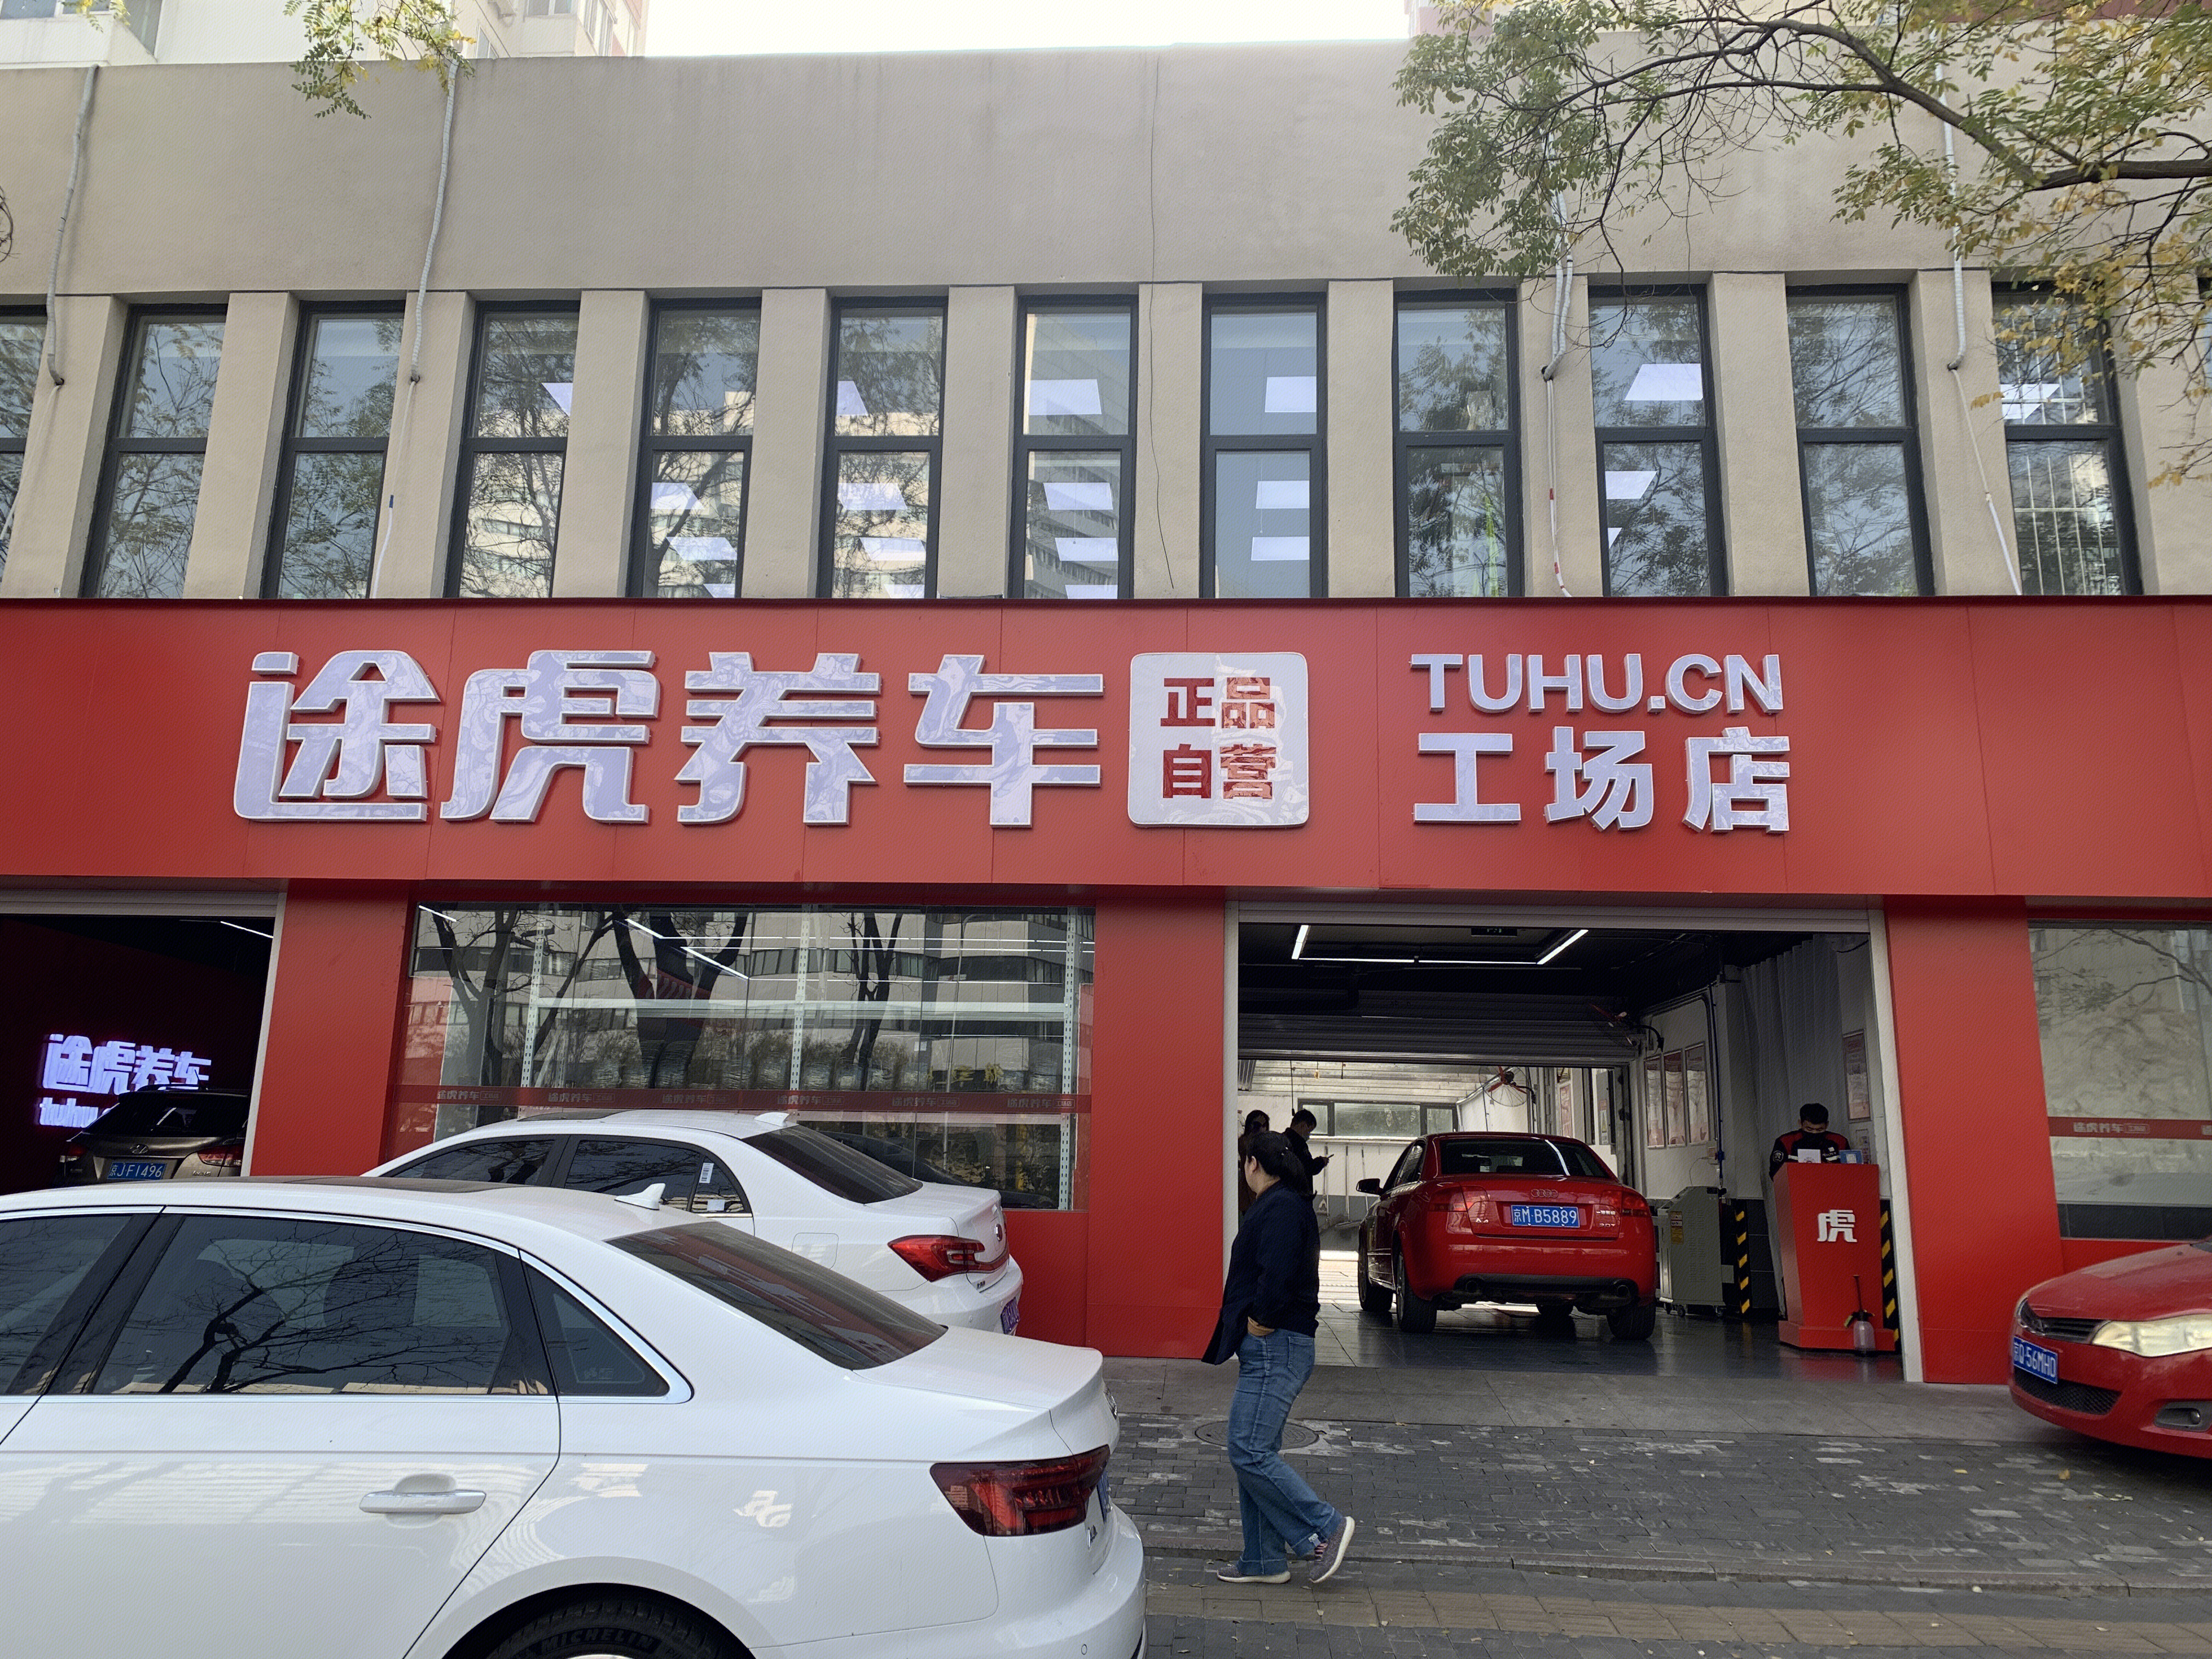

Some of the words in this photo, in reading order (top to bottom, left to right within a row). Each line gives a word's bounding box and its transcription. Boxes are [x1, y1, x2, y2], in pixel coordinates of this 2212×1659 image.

[1160, 677, 1275, 729] 正品
[1410, 653, 1783, 714] TUHU.CN
[234, 650, 1103, 827] 途虎养车
[1163, 743, 1277, 799] 自营
[1412, 726, 1790, 833] 工场店
[42, 1034, 212, 1096] 途虎养车
[1817, 1209, 1858, 1243] 虎
[540, 1627, 654, 1655] MICHELIN
